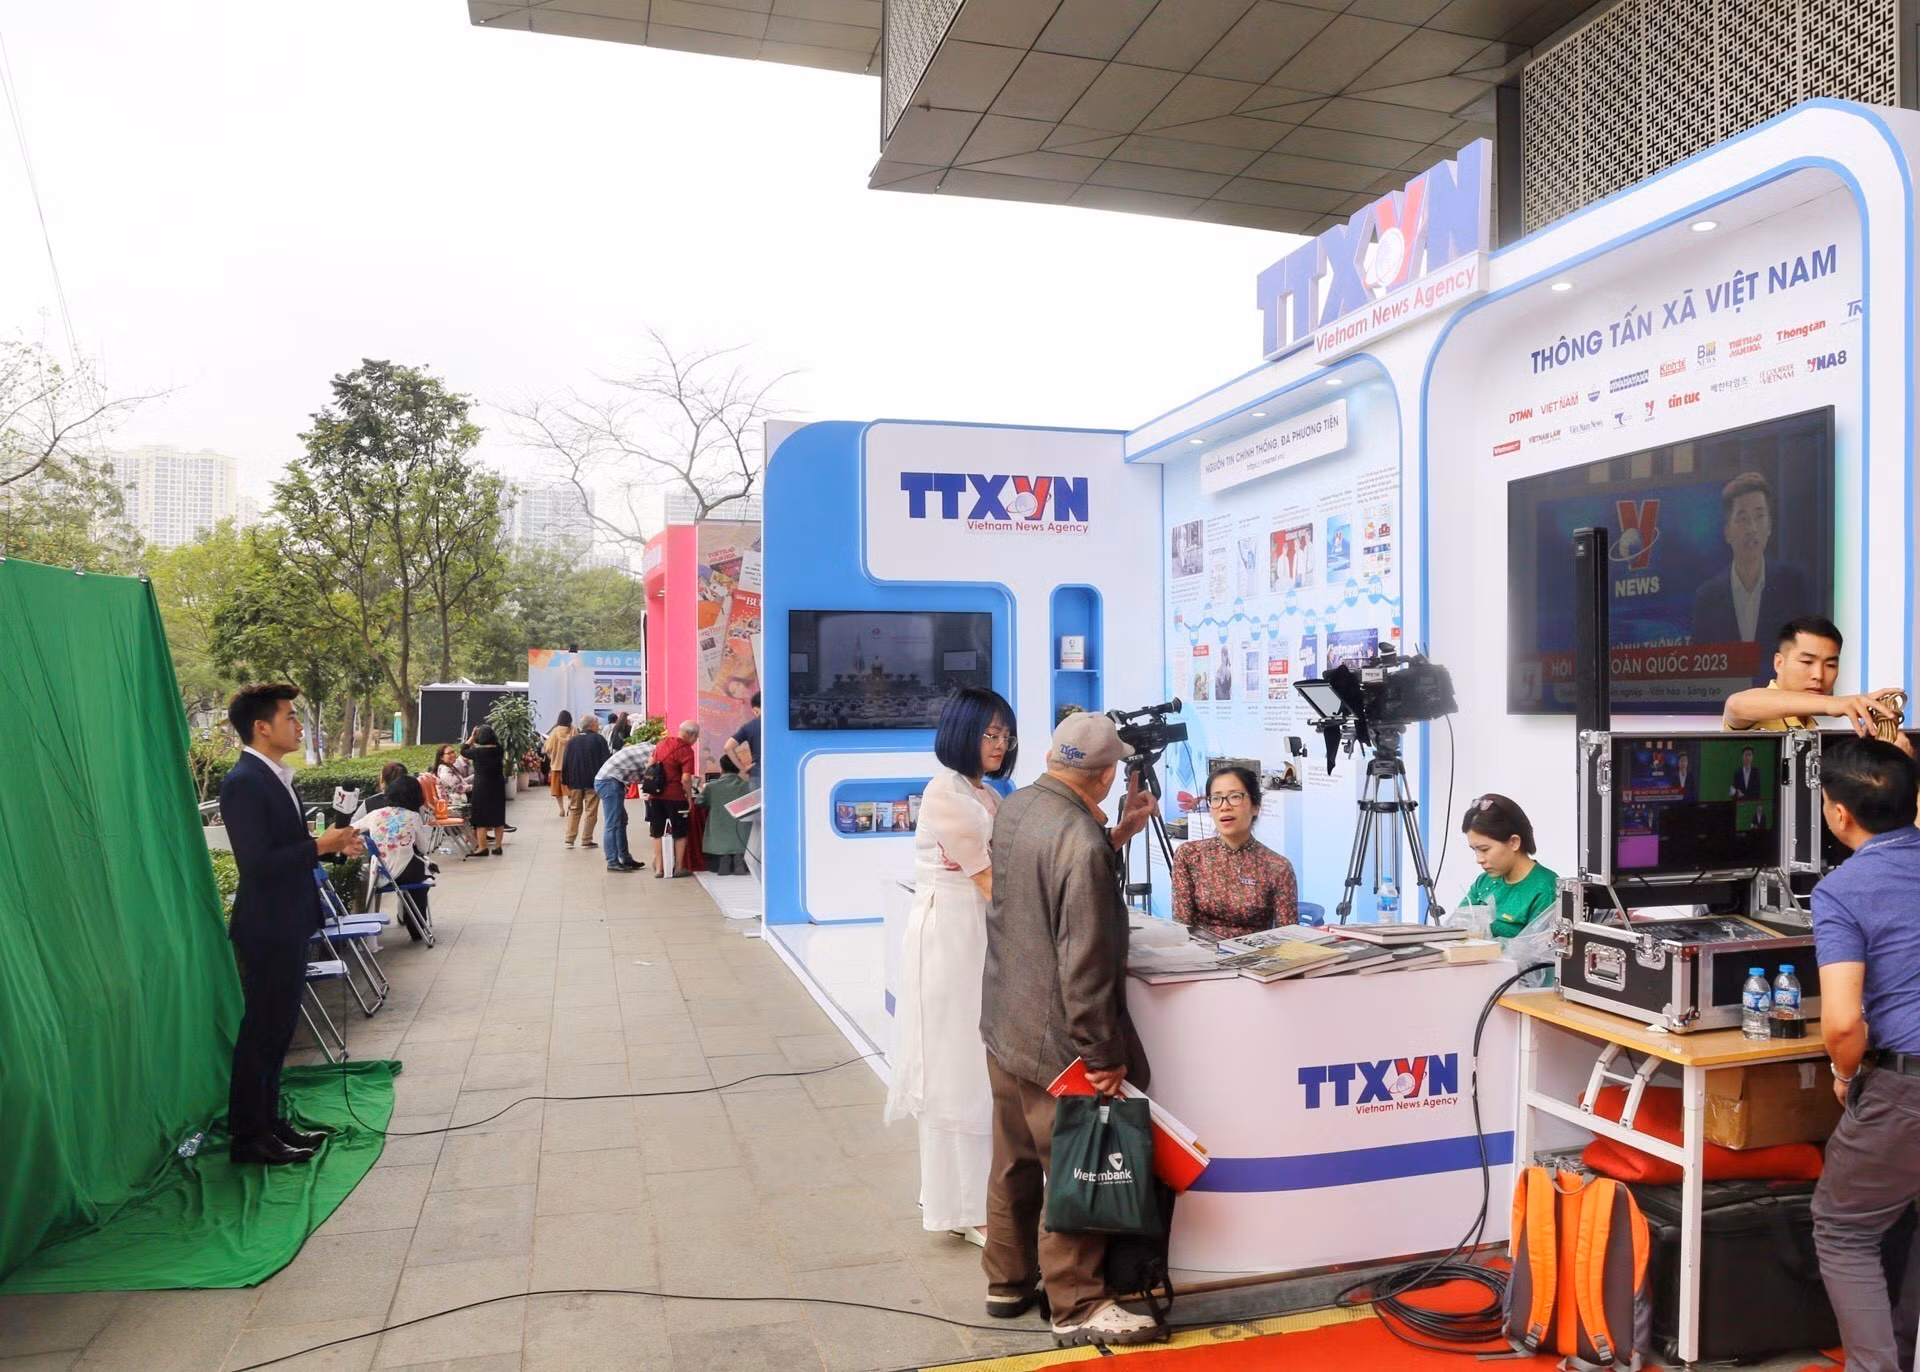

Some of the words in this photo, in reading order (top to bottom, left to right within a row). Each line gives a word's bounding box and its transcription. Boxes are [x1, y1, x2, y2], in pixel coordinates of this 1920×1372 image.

[1316, 316, 1368, 353] Vietnam
[1372, 299, 1409, 329] News
[1413, 265, 1476, 309] Agency
[1531, 330, 1603, 374] THÔNG
[1609, 305, 1652, 347] TẤN
[1662, 289, 1697, 329] XÃ
[1705, 270, 1759, 313] VIỆT
[1768, 244, 1837, 294] NAM
[1226, 453, 1235, 465] TIN
[1236, 446, 1254, 463] CHÍNH
[1281, 435, 1290, 446] ĐA
[1323, 414, 1340, 432] TIỆN
[901, 472, 1089, 522] TTXVN
[967, 520, 1012, 532] Vietnam
[1016, 521, 1044, 532] News
[1047, 522, 1089, 535] Agency
[1614, 576, 1660, 598] NEWS
[1552, 657, 1572, 676] HỘI
[1609, 651, 1642, 674] OÀN
[1646, 650, 1689, 673] QUỐC
[1692, 653, 1728, 673] 2023
[1060, 744, 1087, 760] Tiger
[1298, 1053, 1458, 1109] TTXVN
[1356, 1102, 1394, 1115] Vietnam
[1397, 1100, 1421, 1110] News
[1423, 1097, 1459, 1109] Agency
